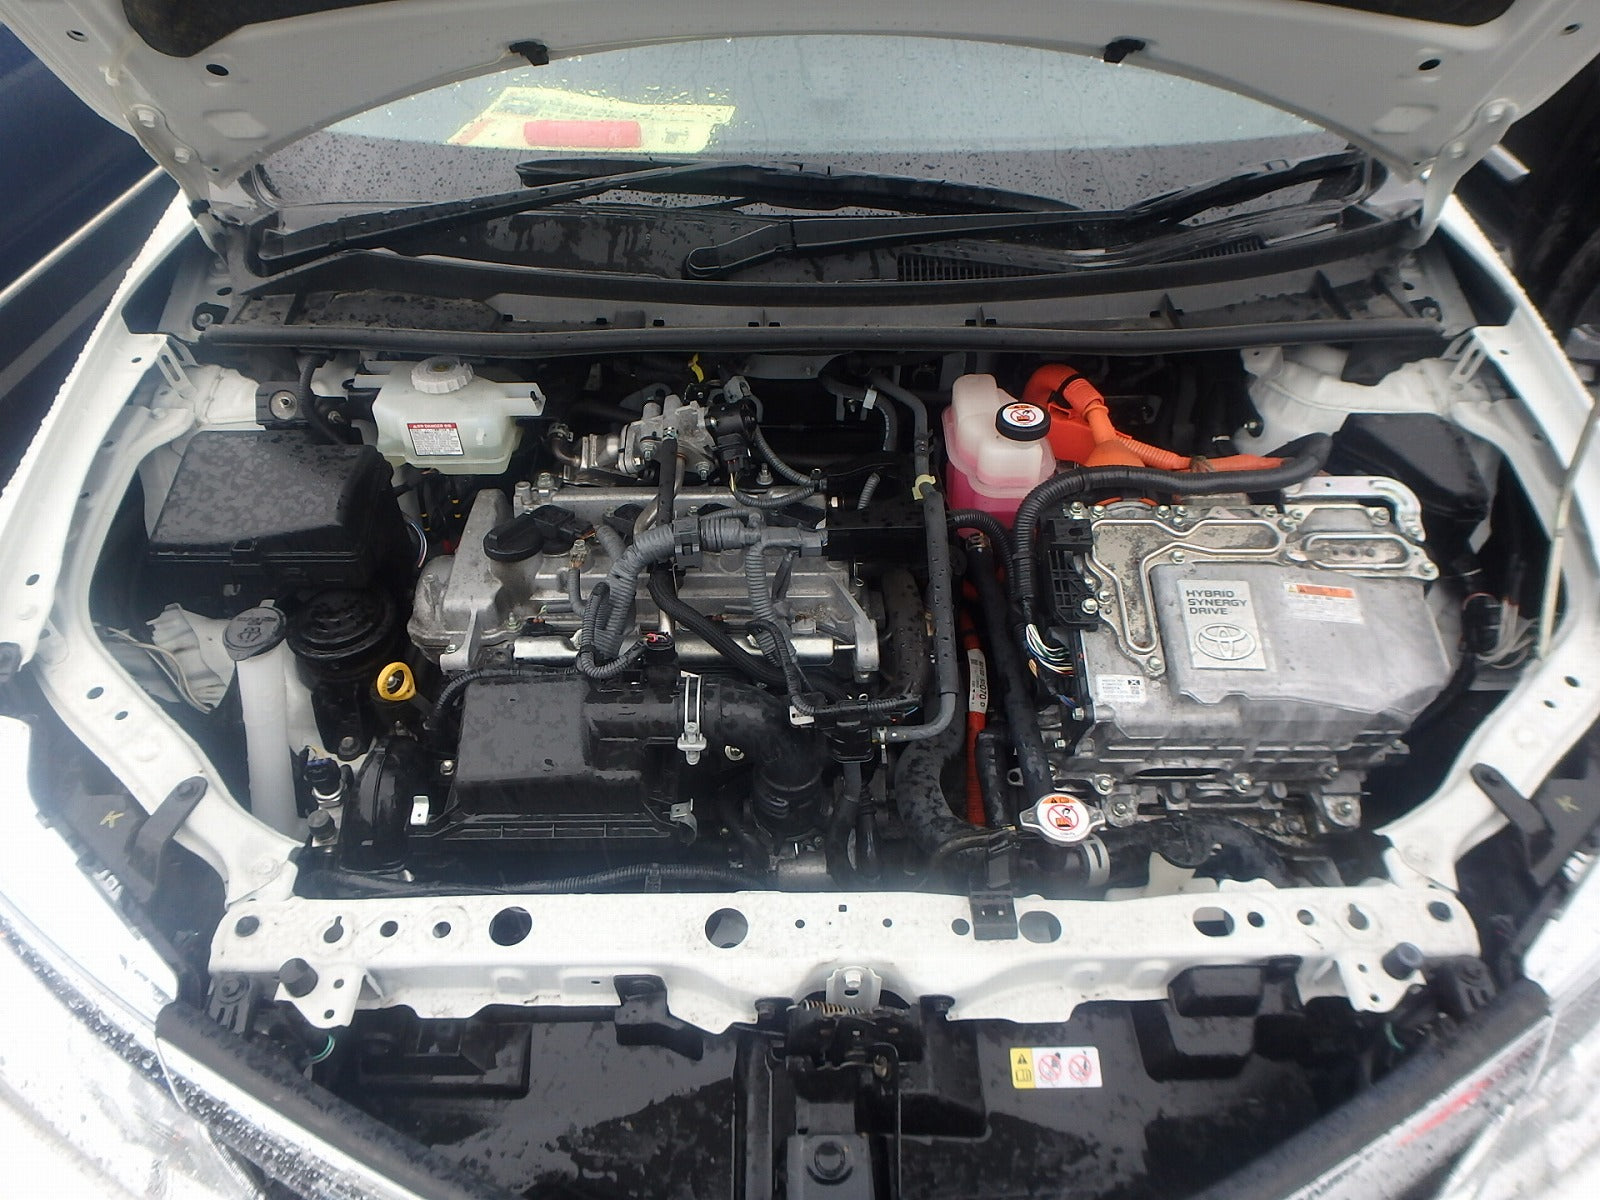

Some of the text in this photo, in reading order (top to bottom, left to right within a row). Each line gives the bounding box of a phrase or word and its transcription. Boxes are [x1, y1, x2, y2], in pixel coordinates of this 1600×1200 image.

[1186, 590, 1235, 598] HYBRID
[1188, 598, 1248, 607] SYNERGY
[1189, 607, 1229, 615] DRIVE
